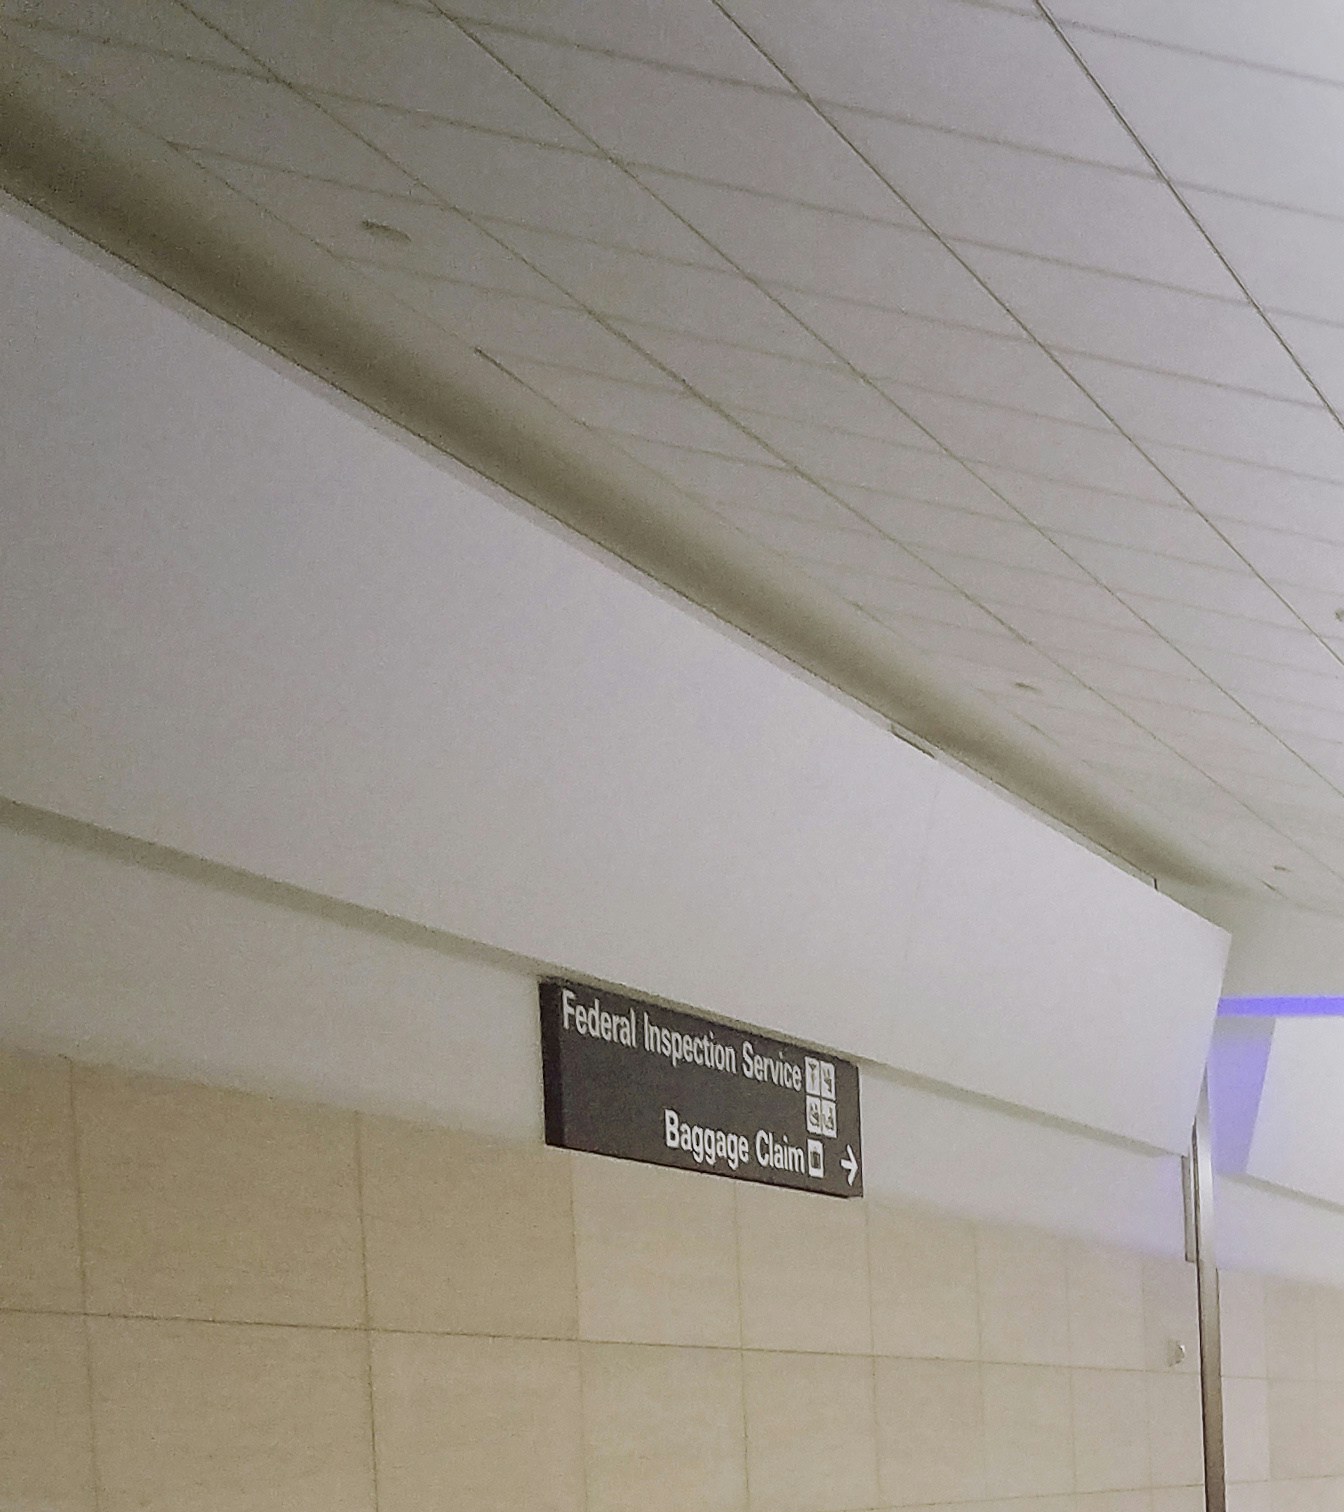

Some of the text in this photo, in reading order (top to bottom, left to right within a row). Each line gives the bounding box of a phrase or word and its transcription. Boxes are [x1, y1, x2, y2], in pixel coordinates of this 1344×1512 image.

[562, 990, 803, 1092] Federal Inspection Service
[664, 1108, 805, 1174] Baggage Claim
